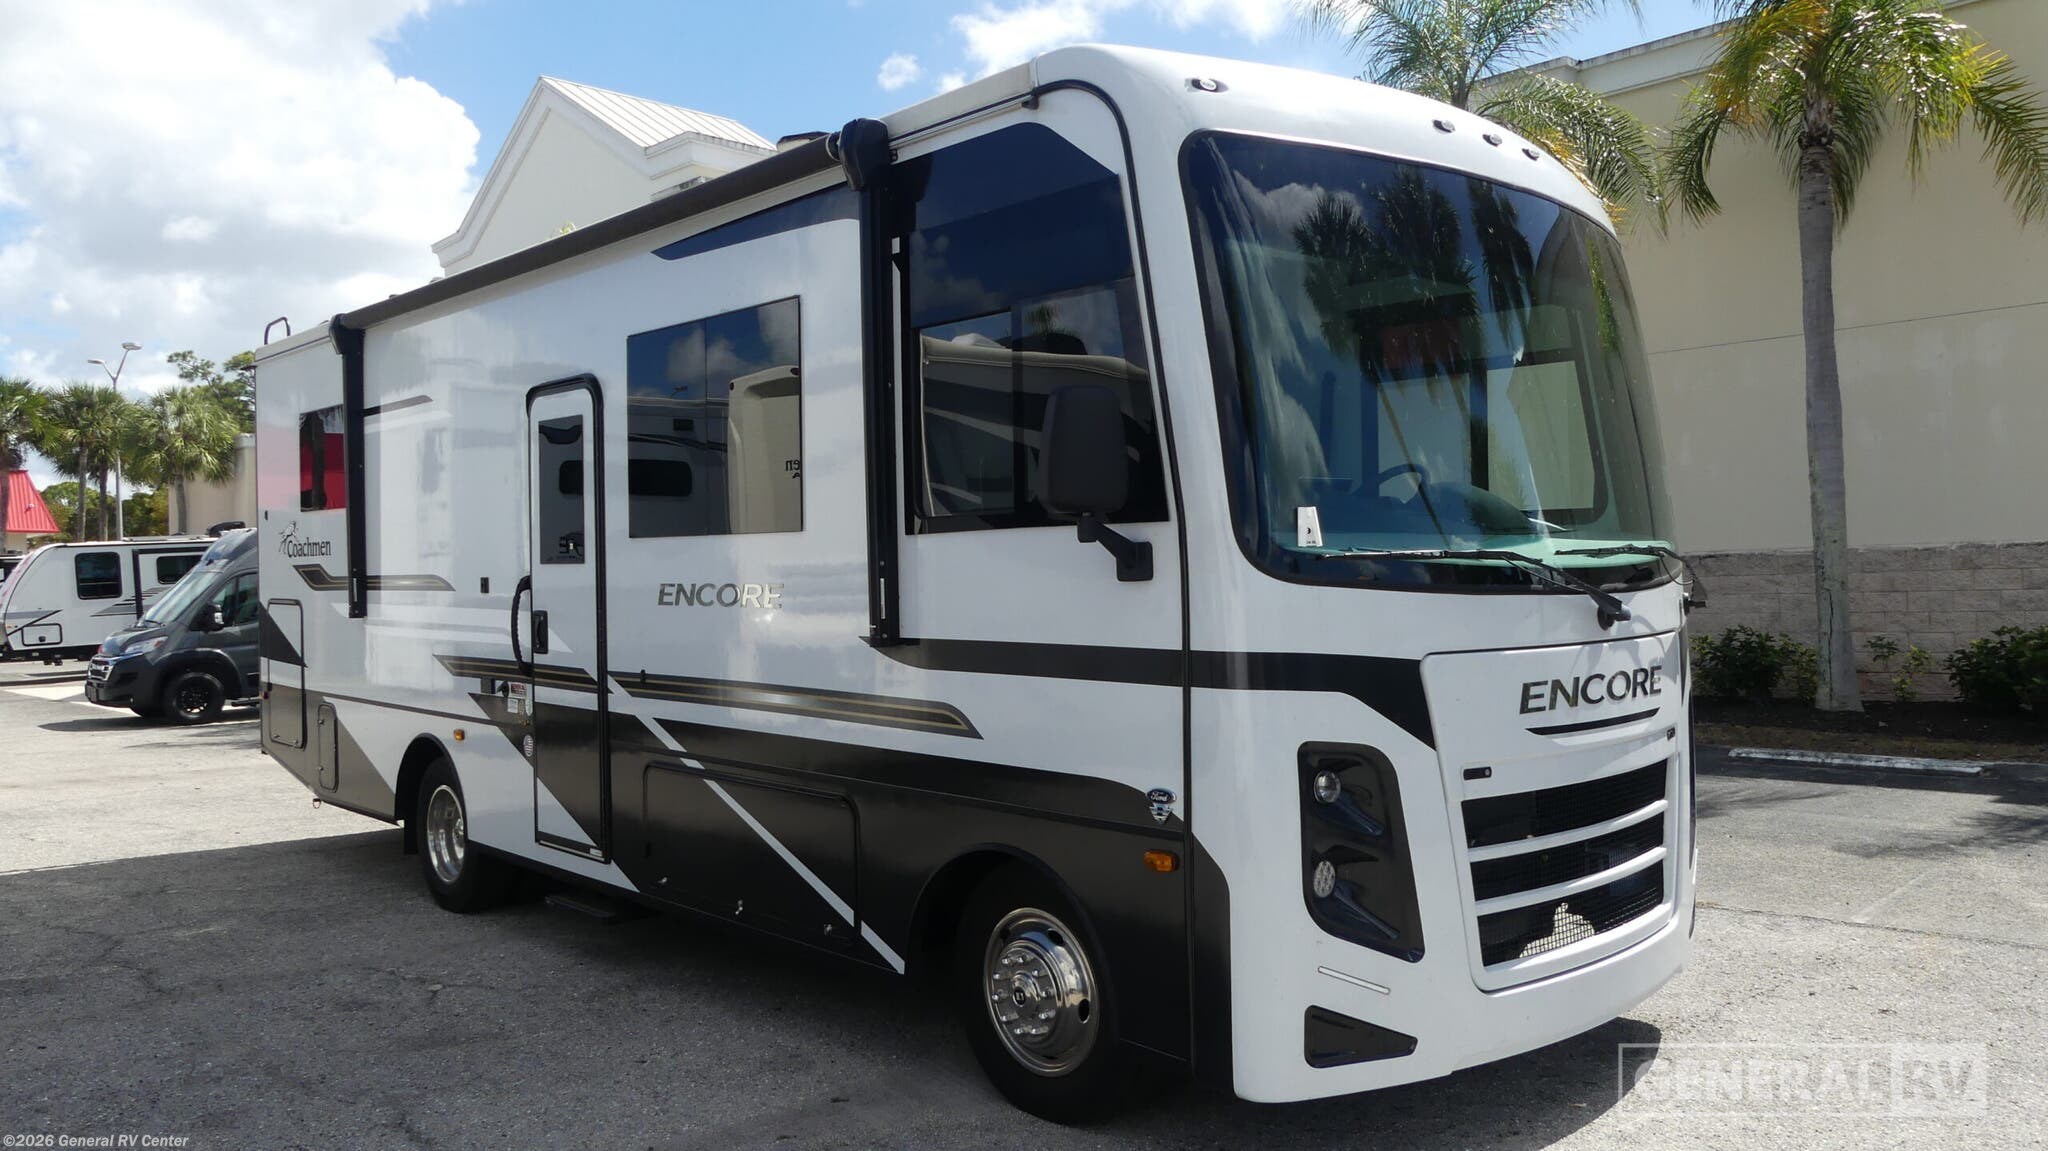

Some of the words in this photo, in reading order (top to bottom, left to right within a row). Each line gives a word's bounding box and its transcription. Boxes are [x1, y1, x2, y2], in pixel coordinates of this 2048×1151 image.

[287, 536, 332, 558] Coachmen
[657, 582, 785, 608] ENCORE
[1519, 665, 1662, 715] ENCORE
